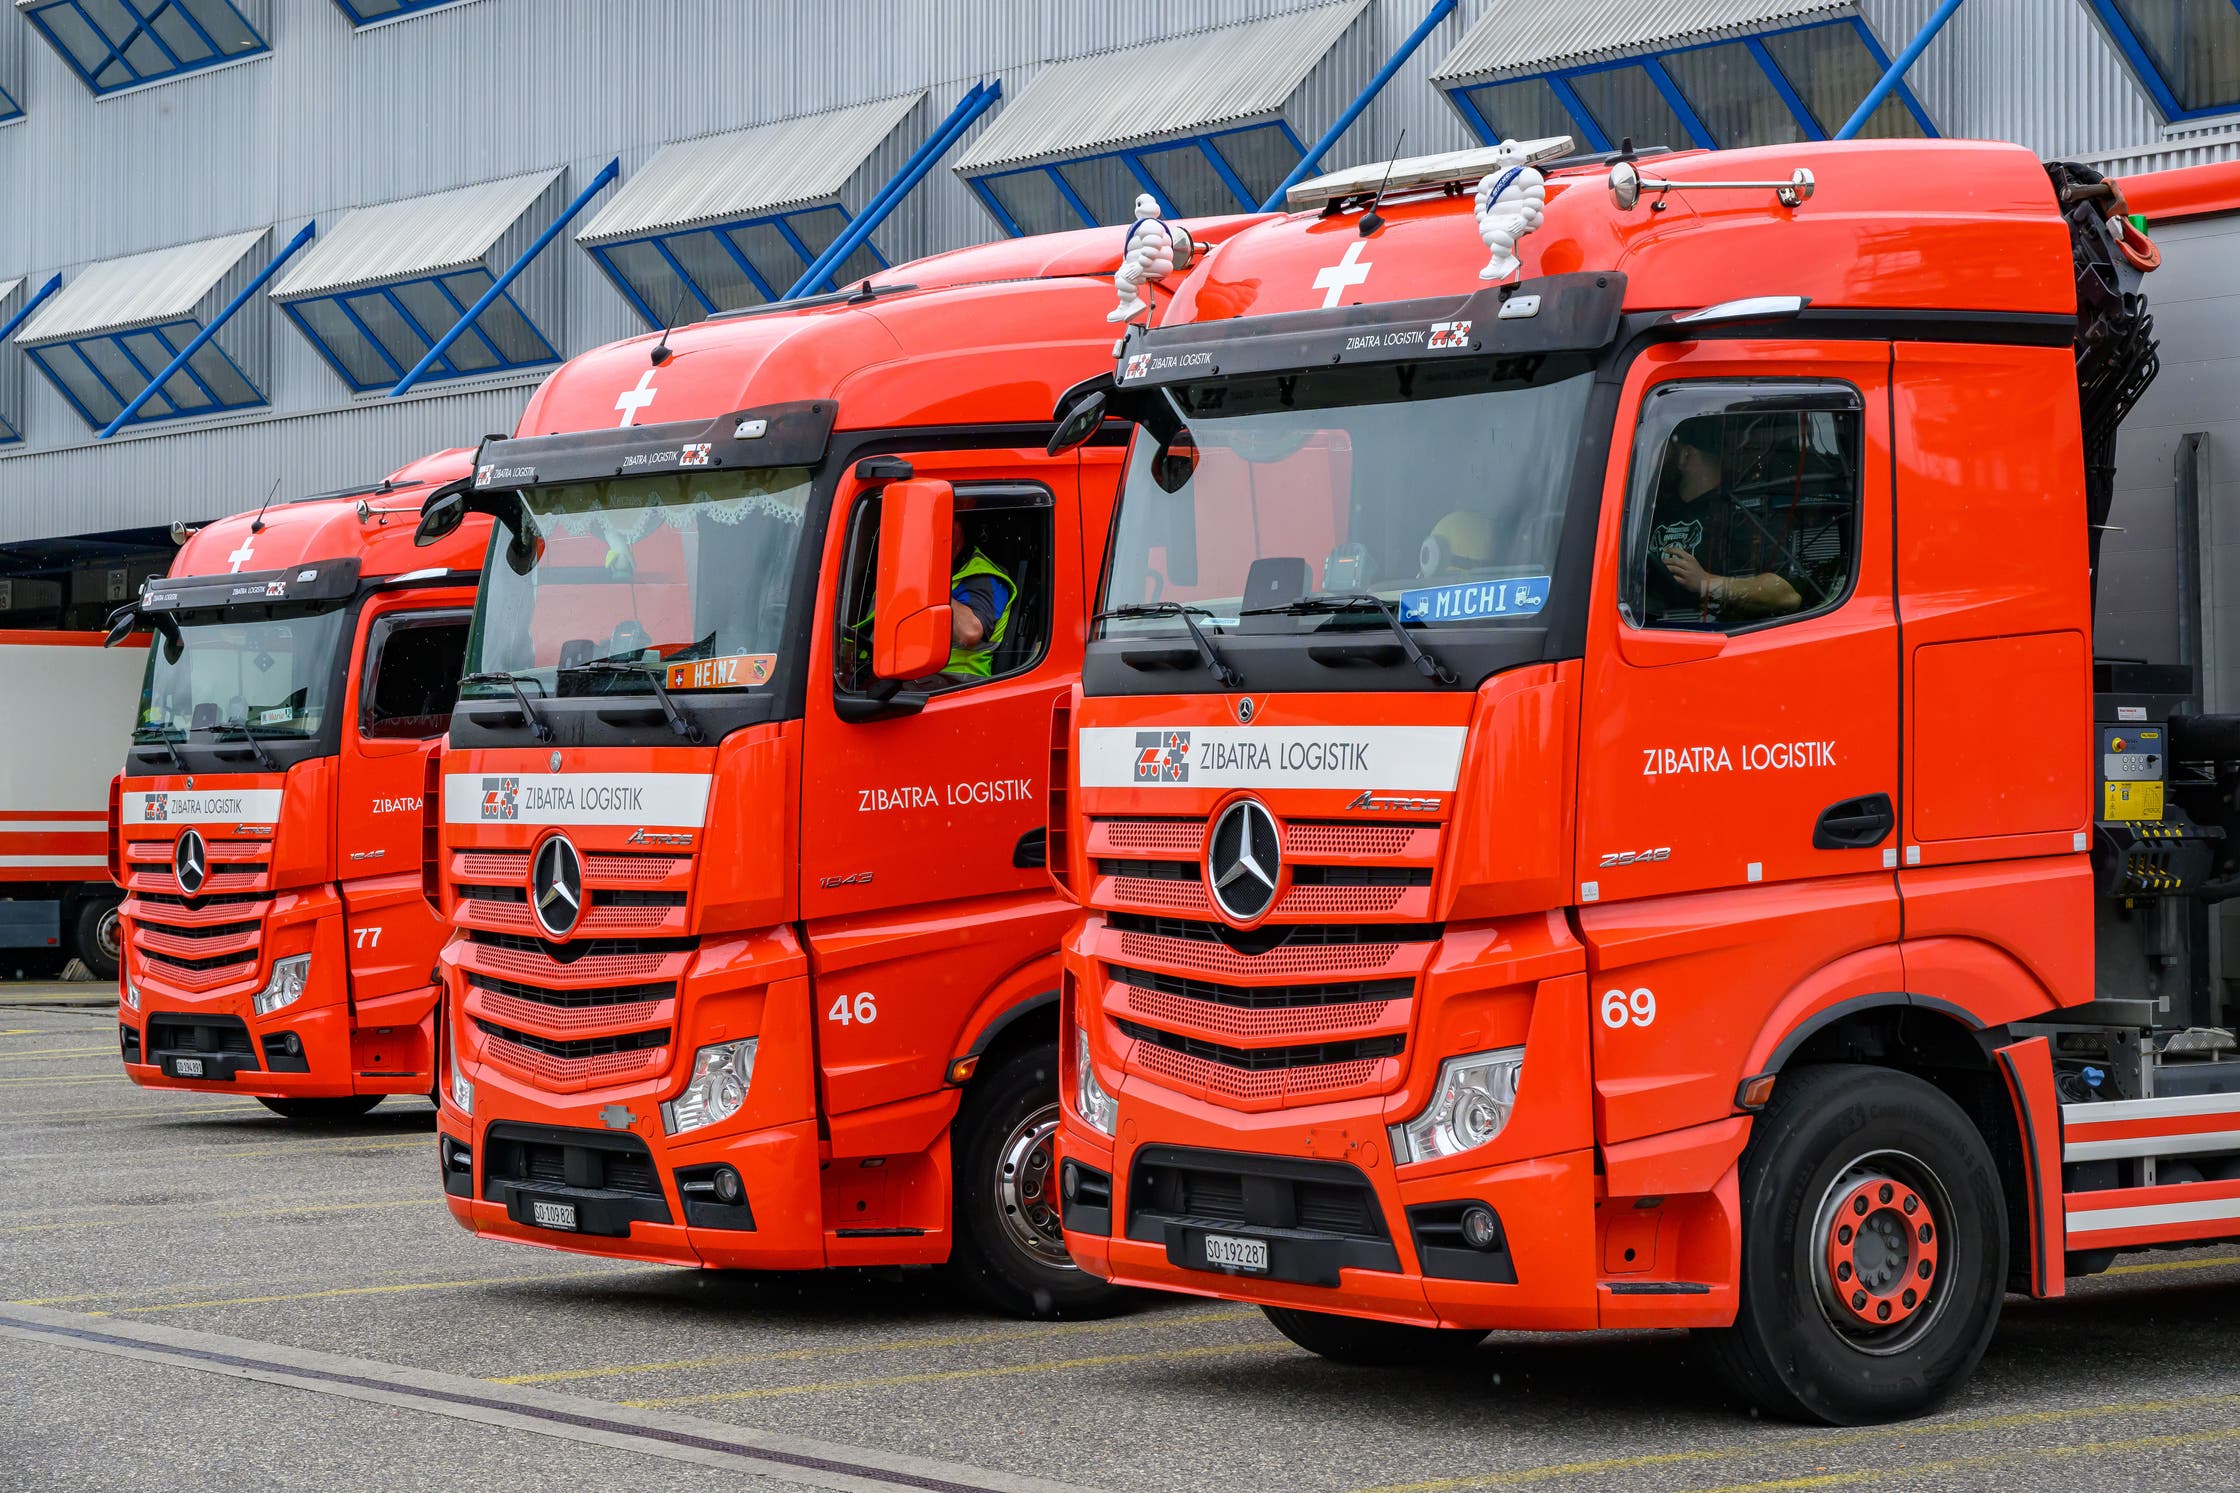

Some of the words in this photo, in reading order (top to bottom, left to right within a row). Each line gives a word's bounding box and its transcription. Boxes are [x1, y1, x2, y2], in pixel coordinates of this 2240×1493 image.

[1346, 335, 1380, 350] ZIBATRA
[1383, 331, 1426, 347] LOGISTIK
[1151, 356, 1177, 370] ZIBATRA
[1180, 352, 1213, 366] LOGISTIK
[623, 455, 647, 467] ZIBATRA
[649, 451, 679, 464] LOGISTIK
[1436, 585, 1507, 618] MICHI
[694, 660, 738, 688] HEINZ
[1200, 742, 1271, 770] ZIBATRA
[1280, 742, 1369, 771] LOGISTIK
[1643, 746, 1733, 775] ZIBATRA
[1742, 741, 1836, 771] LOGISTIK
[171, 799, 201, 814] ZIBATRA
[204, 799, 242, 814] LOGISTIK
[372, 797, 423, 814] ZIBATRA
[525, 787, 575, 810] ZIBATRA
[580, 787, 643, 811] LOGISTIK
[858, 786, 939, 811] ZIBATRA
[947, 779, 1032, 805] LOGISTIK
[1600, 847, 1671, 869] 2548
[353, 927, 382, 949] 77
[828, 992, 877, 1026] 46
[1601, 988, 1656, 1029] 69
